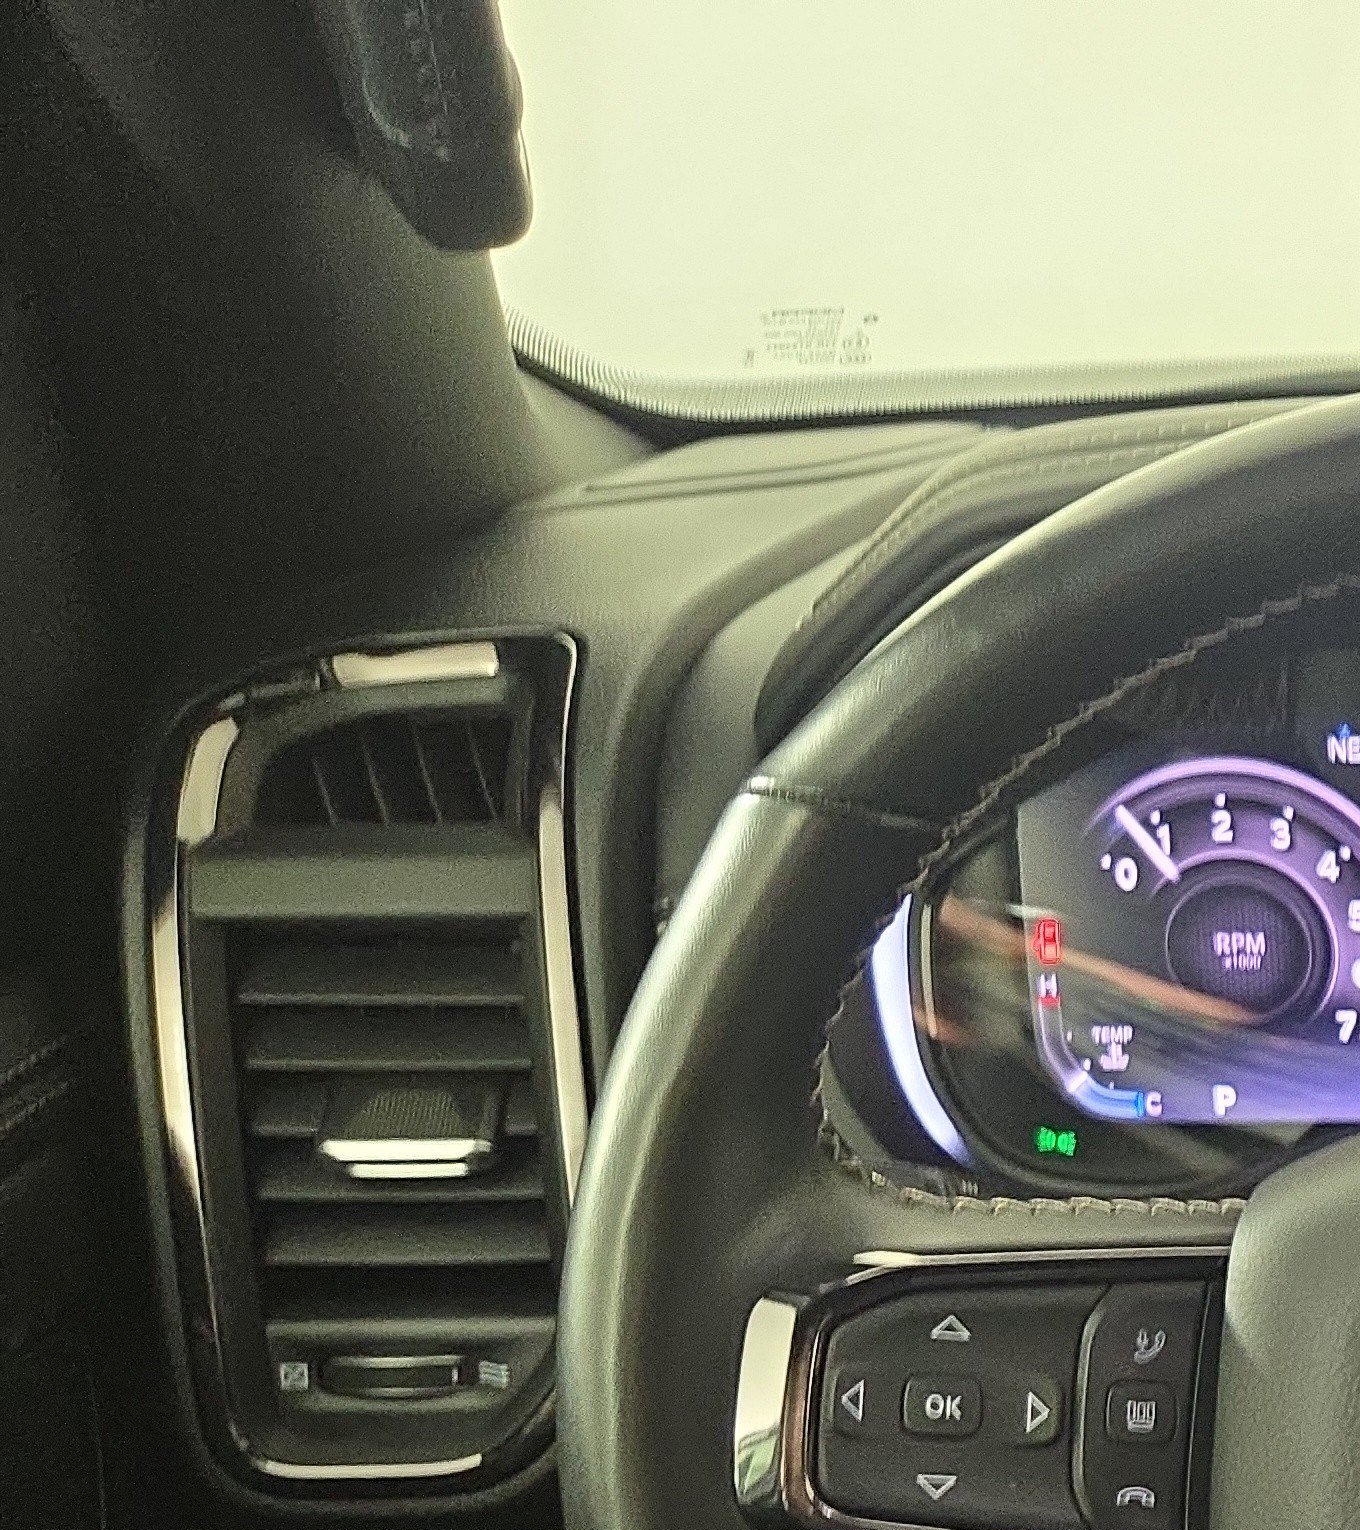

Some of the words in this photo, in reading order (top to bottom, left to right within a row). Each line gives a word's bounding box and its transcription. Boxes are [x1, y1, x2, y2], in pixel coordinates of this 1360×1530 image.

[1157, 823, 1172, 855] 1
[1211, 809, 1234, 843] 2
[1270, 817, 1291, 850] 3
[1115, 857, 1138, 892] 0
[1316, 850, 1340, 883] 4
[1214, 932, 1266, 956] RPM
[1039, 973, 1058, 997] H
[1091, 1025, 1134, 1045] TEMP
[1335, 1009, 1358, 1044] 7
[1145, 1091, 1162, 1116] C
[1212, 1084, 1236, 1117] P
[925, 1393, 963, 1421] OK
